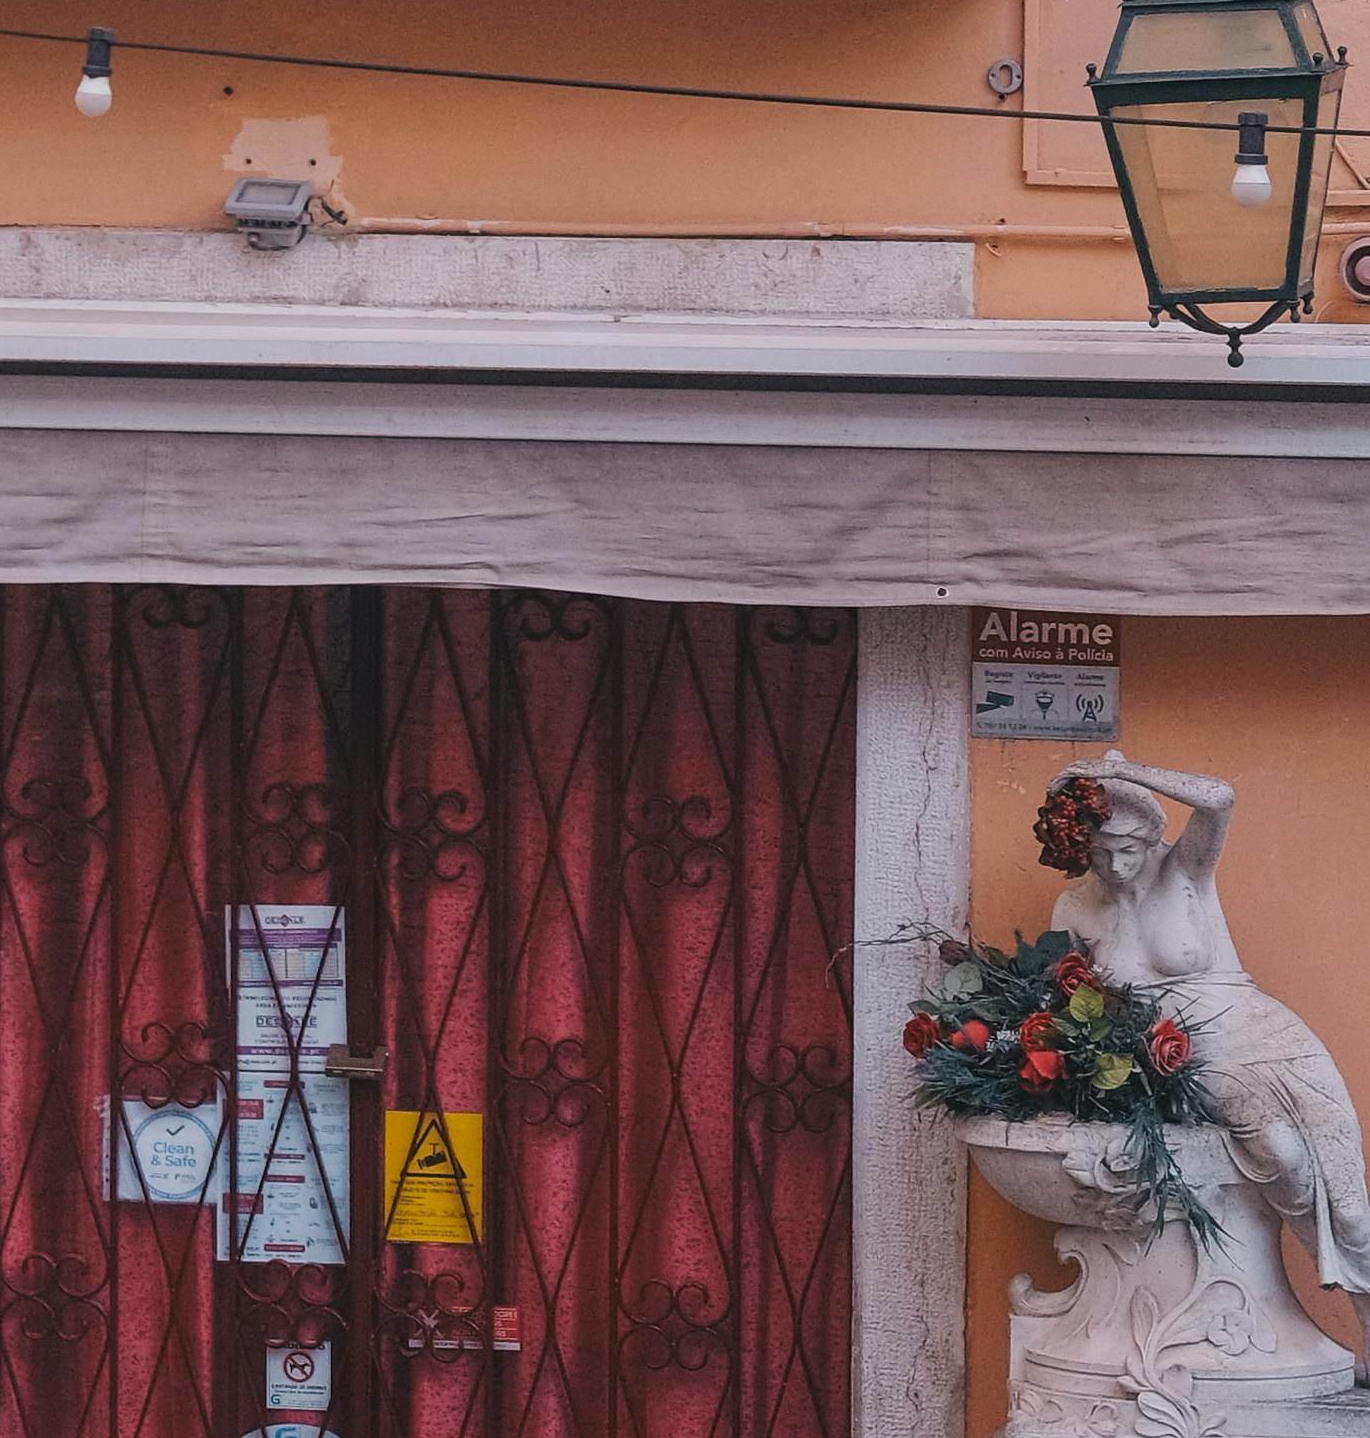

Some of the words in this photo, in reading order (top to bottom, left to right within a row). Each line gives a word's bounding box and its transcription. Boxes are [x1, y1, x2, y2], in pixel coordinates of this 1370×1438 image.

[978, 611, 1114, 645] Alarme
[979, 647, 1009, 658] com
[1012, 647, 1052, 660] Aviso
[1068, 648, 1114, 662] Polícia
[152, 1141, 195, 1155] Clean
[164, 1155, 198, 1168] Safe
